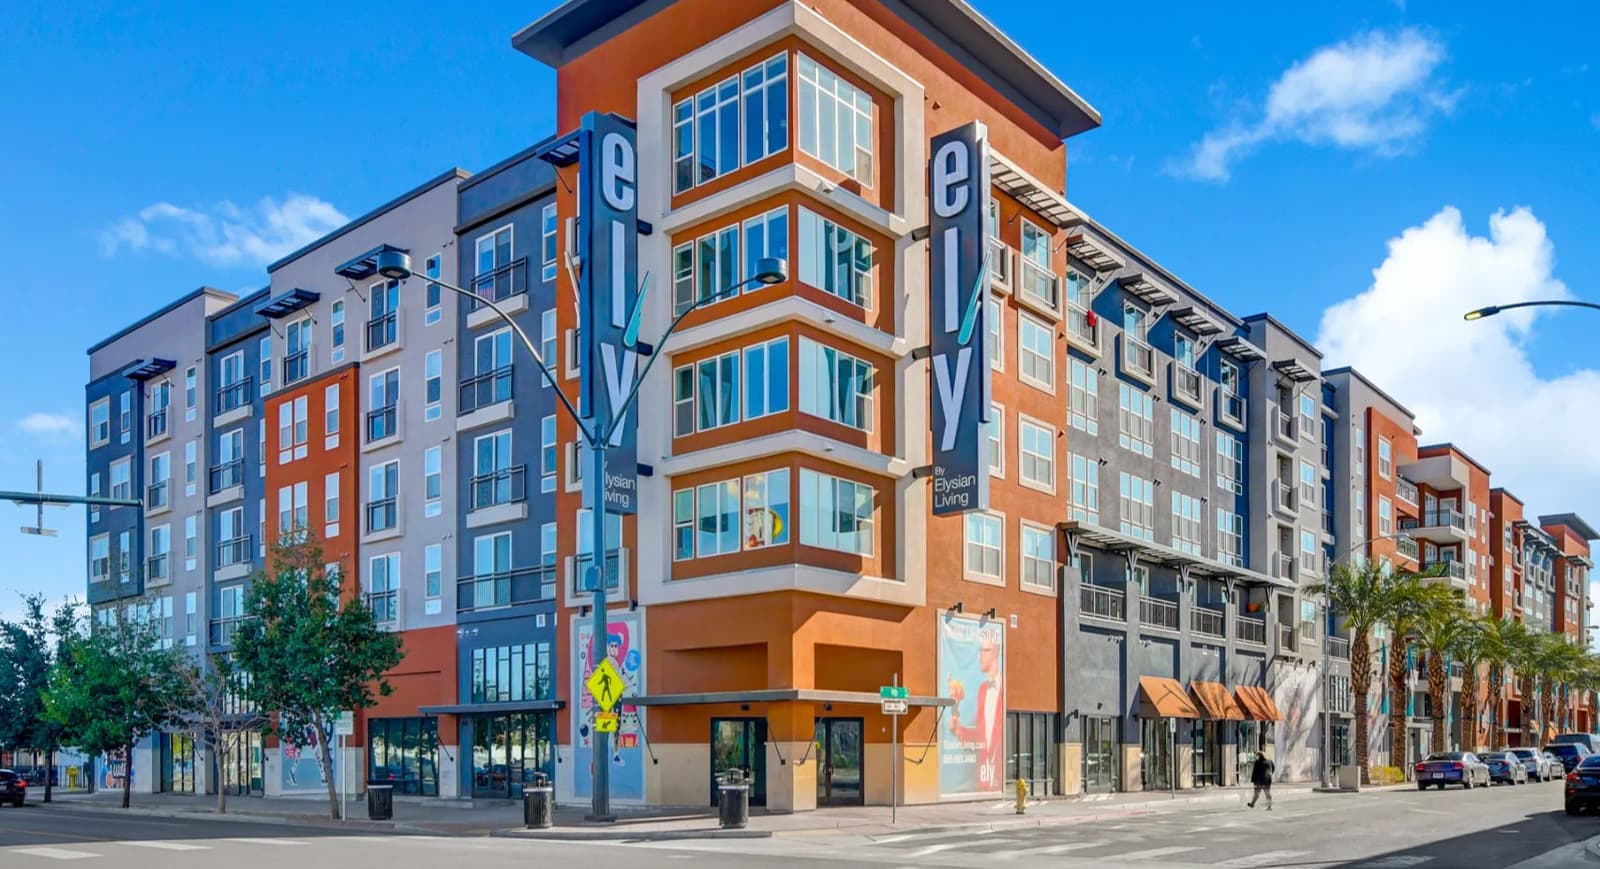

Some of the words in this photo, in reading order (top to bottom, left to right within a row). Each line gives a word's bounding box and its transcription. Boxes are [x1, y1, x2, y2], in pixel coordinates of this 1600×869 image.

[605, 471, 636, 490] lysian
[934, 466, 945, 476] By
[935, 474, 976, 493] Elysian
[605, 488, 630, 508] iving
[935, 492, 969, 507] Living
[980, 756, 995, 787] ely
